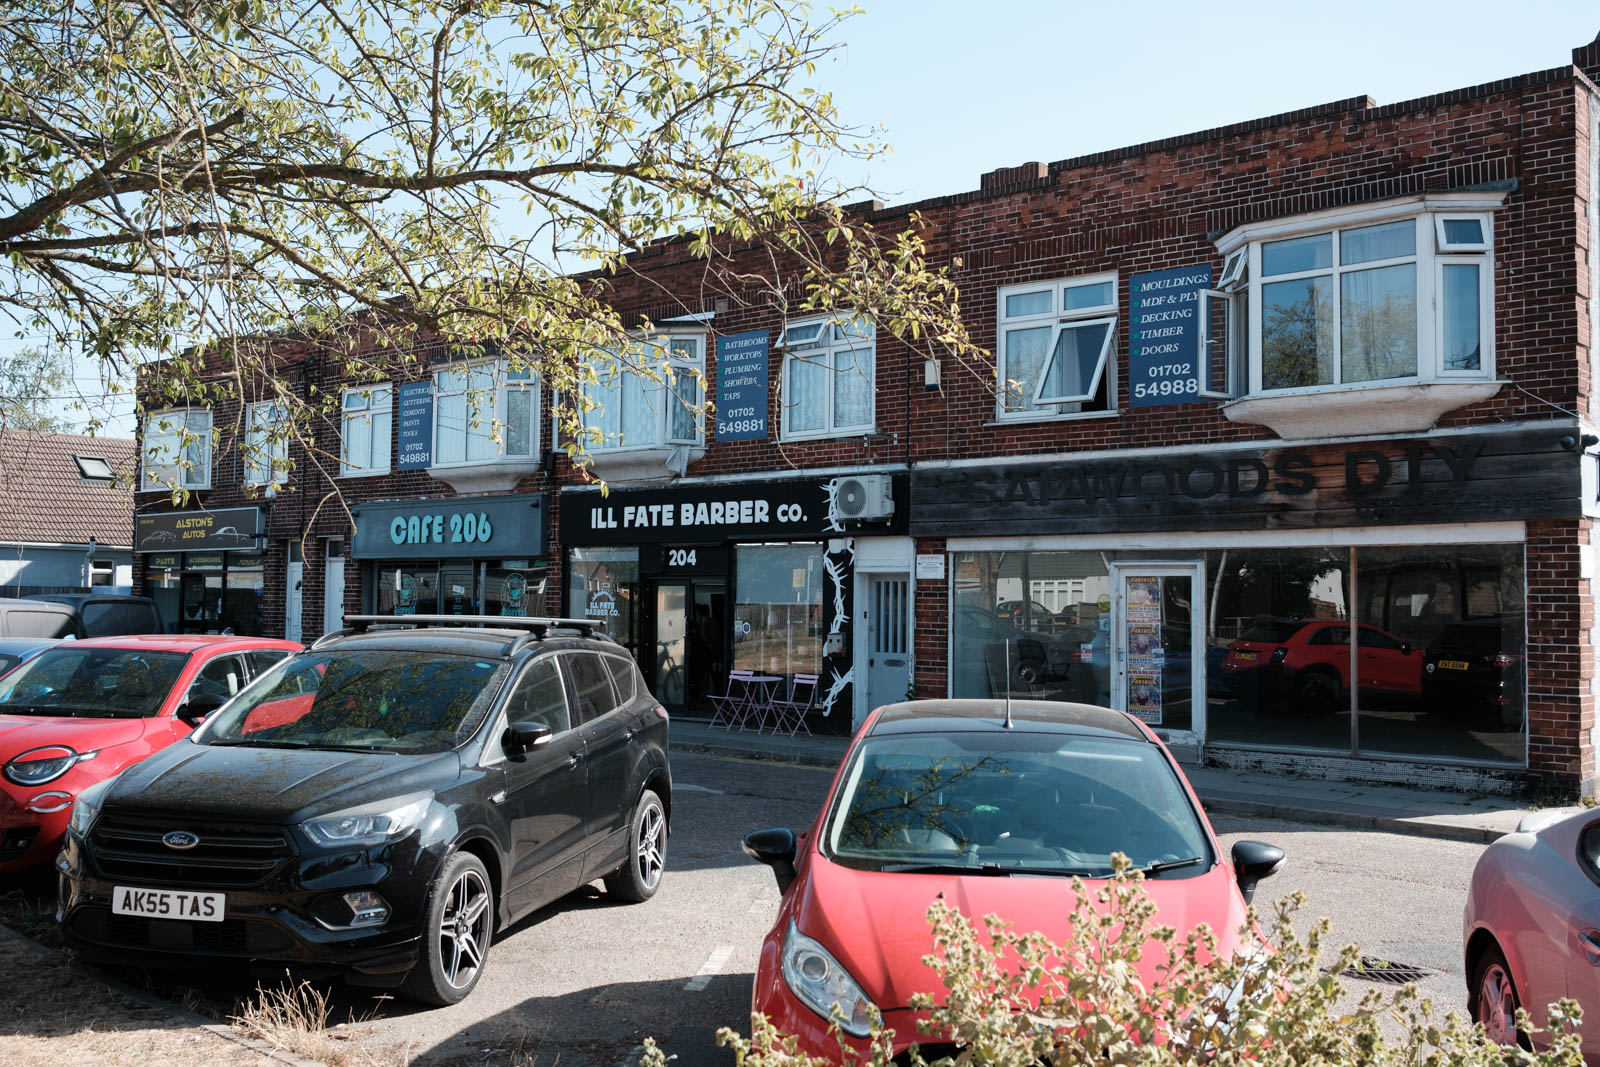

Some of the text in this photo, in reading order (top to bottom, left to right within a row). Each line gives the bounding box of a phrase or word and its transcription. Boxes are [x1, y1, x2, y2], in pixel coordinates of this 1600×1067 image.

[1140, 274, 1209, 292] MOULDINGS
[1140, 291, 1199, 308] MDF & PLY
[1140, 309, 1192, 324] DECKING
[1140, 326, 1184, 339] TIMBER
[725, 336, 767, 350] BATHROOMS
[1140, 343, 1179, 356] DOORS
[724, 350, 762, 362] WORKTOPS
[724, 364, 761, 375] PLUMBING
[1148, 363, 1191, 378] 01702
[724, 377, 758, 388] SHOWERS
[1134, 378, 1198, 398] 54988
[403, 397, 432, 407] GUTTERING
[724, 392, 741, 401] TAPS
[403, 408, 425, 417] CEMENTS
[728, 407, 755, 418] 01702
[403, 419, 420, 427] PAINTS
[718, 419, 764, 434] 549881
[405, 443, 423, 451] 01702
[400, 452, 430, 464] 549881
[1345, 443, 1485, 494] DIY
[591, 500, 808, 529] ILL FATE BARBER CO.
[176, 517, 214, 528] ALSTON'S
[390, 512, 493, 545] CAFE 206
[182, 530, 206, 539] AUTOS
[669, 549, 697, 566] 204
[600, 602, 615, 610] FATE
[122, 890, 216, 917] AK55 TAS
